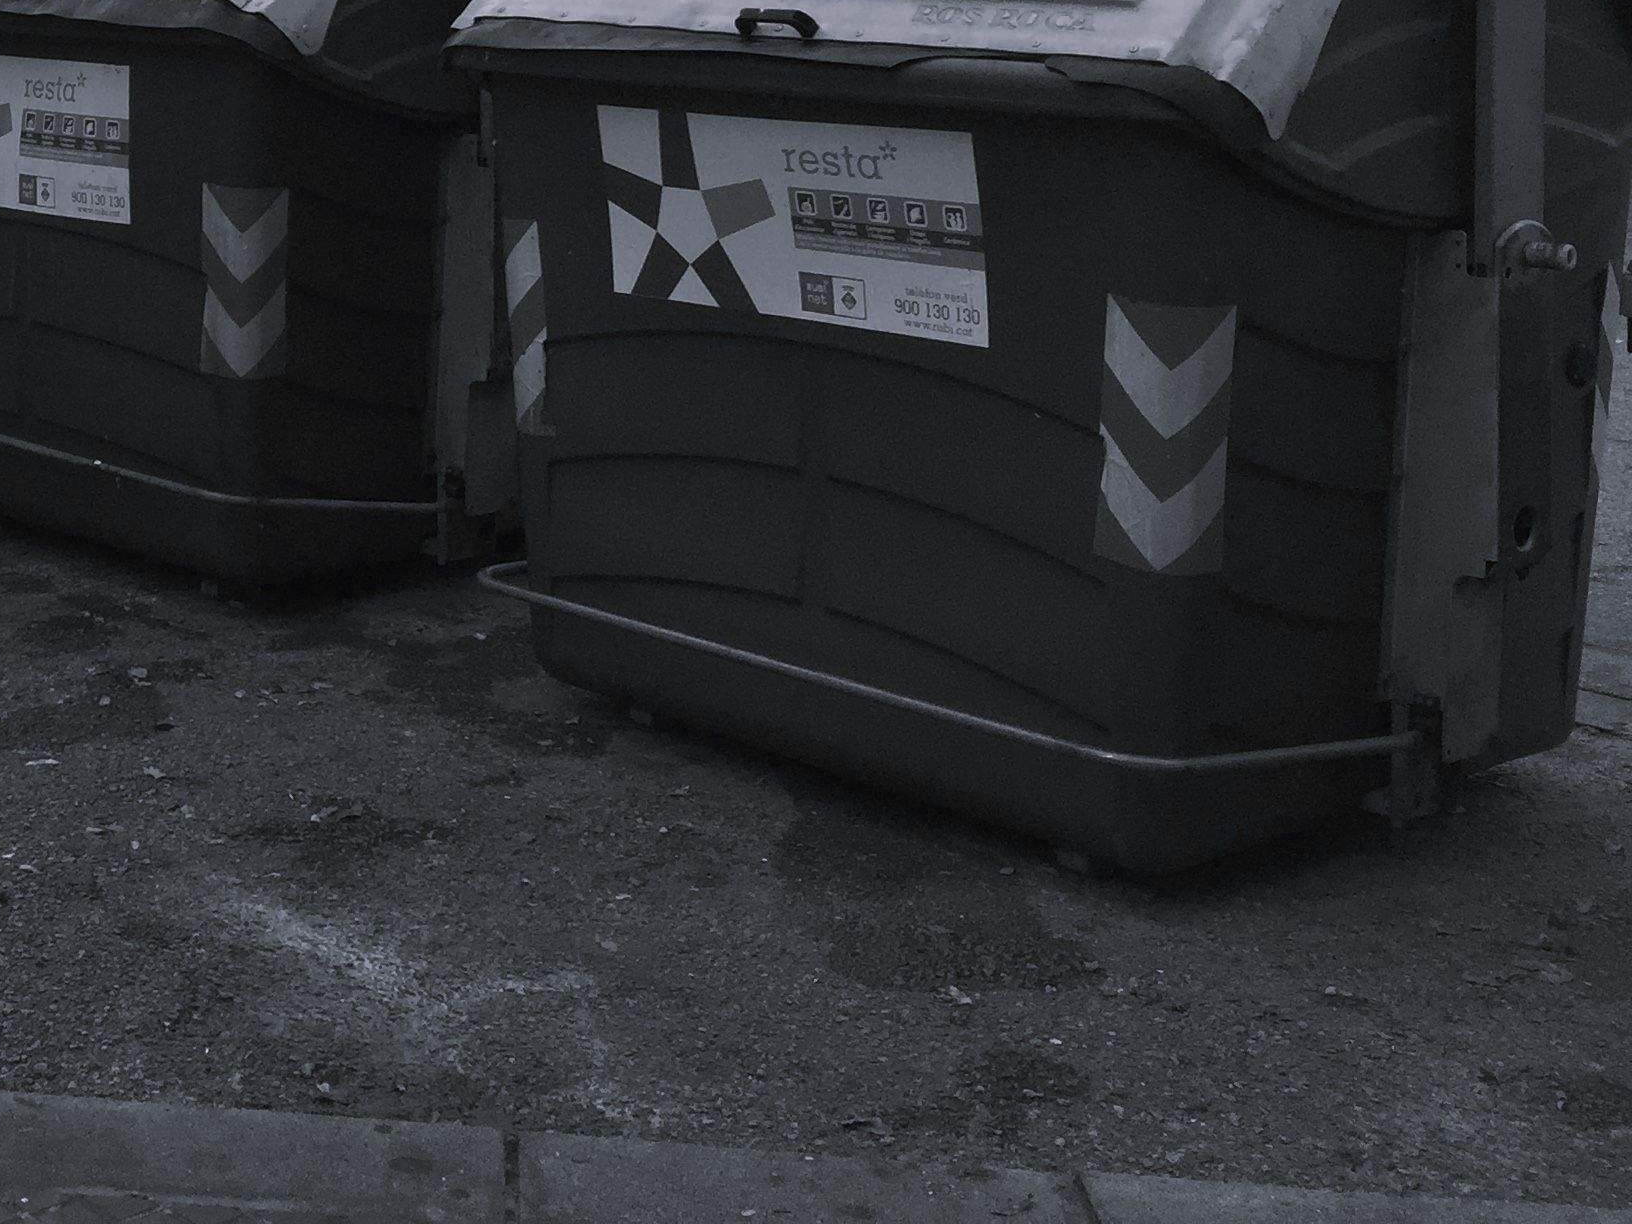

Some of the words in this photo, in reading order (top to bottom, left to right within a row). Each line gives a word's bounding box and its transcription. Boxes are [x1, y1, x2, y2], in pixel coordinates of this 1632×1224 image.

[894, 298, 920, 316] 900
[926, 303, 950, 320] 130
[956, 307, 981, 325] 130
